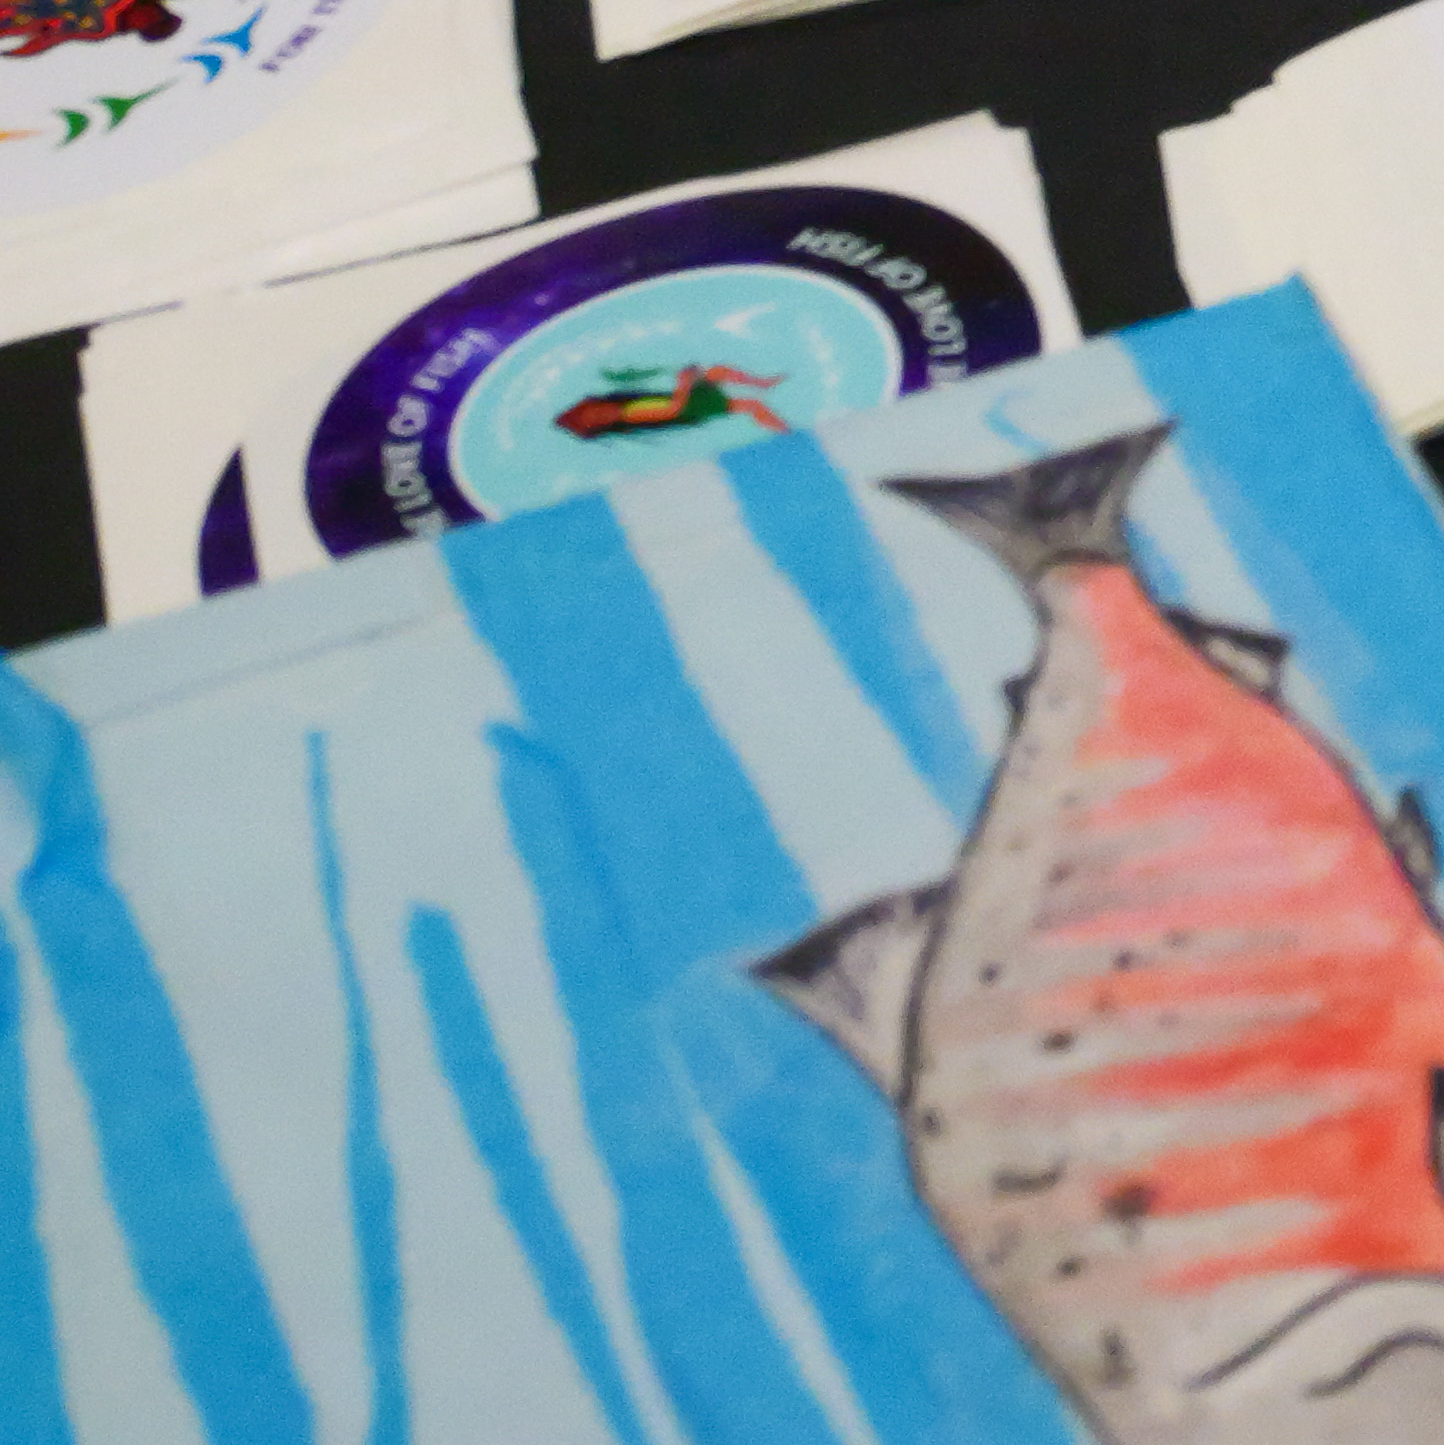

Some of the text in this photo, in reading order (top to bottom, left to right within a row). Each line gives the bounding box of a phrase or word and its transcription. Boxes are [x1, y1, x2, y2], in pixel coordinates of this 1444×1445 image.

[785, 225, 969, 357] LOVE OF FISH
[409, 325, 501, 393] FISH
[386, 393, 433, 439] OF
[380, 439, 433, 513] LOVE
